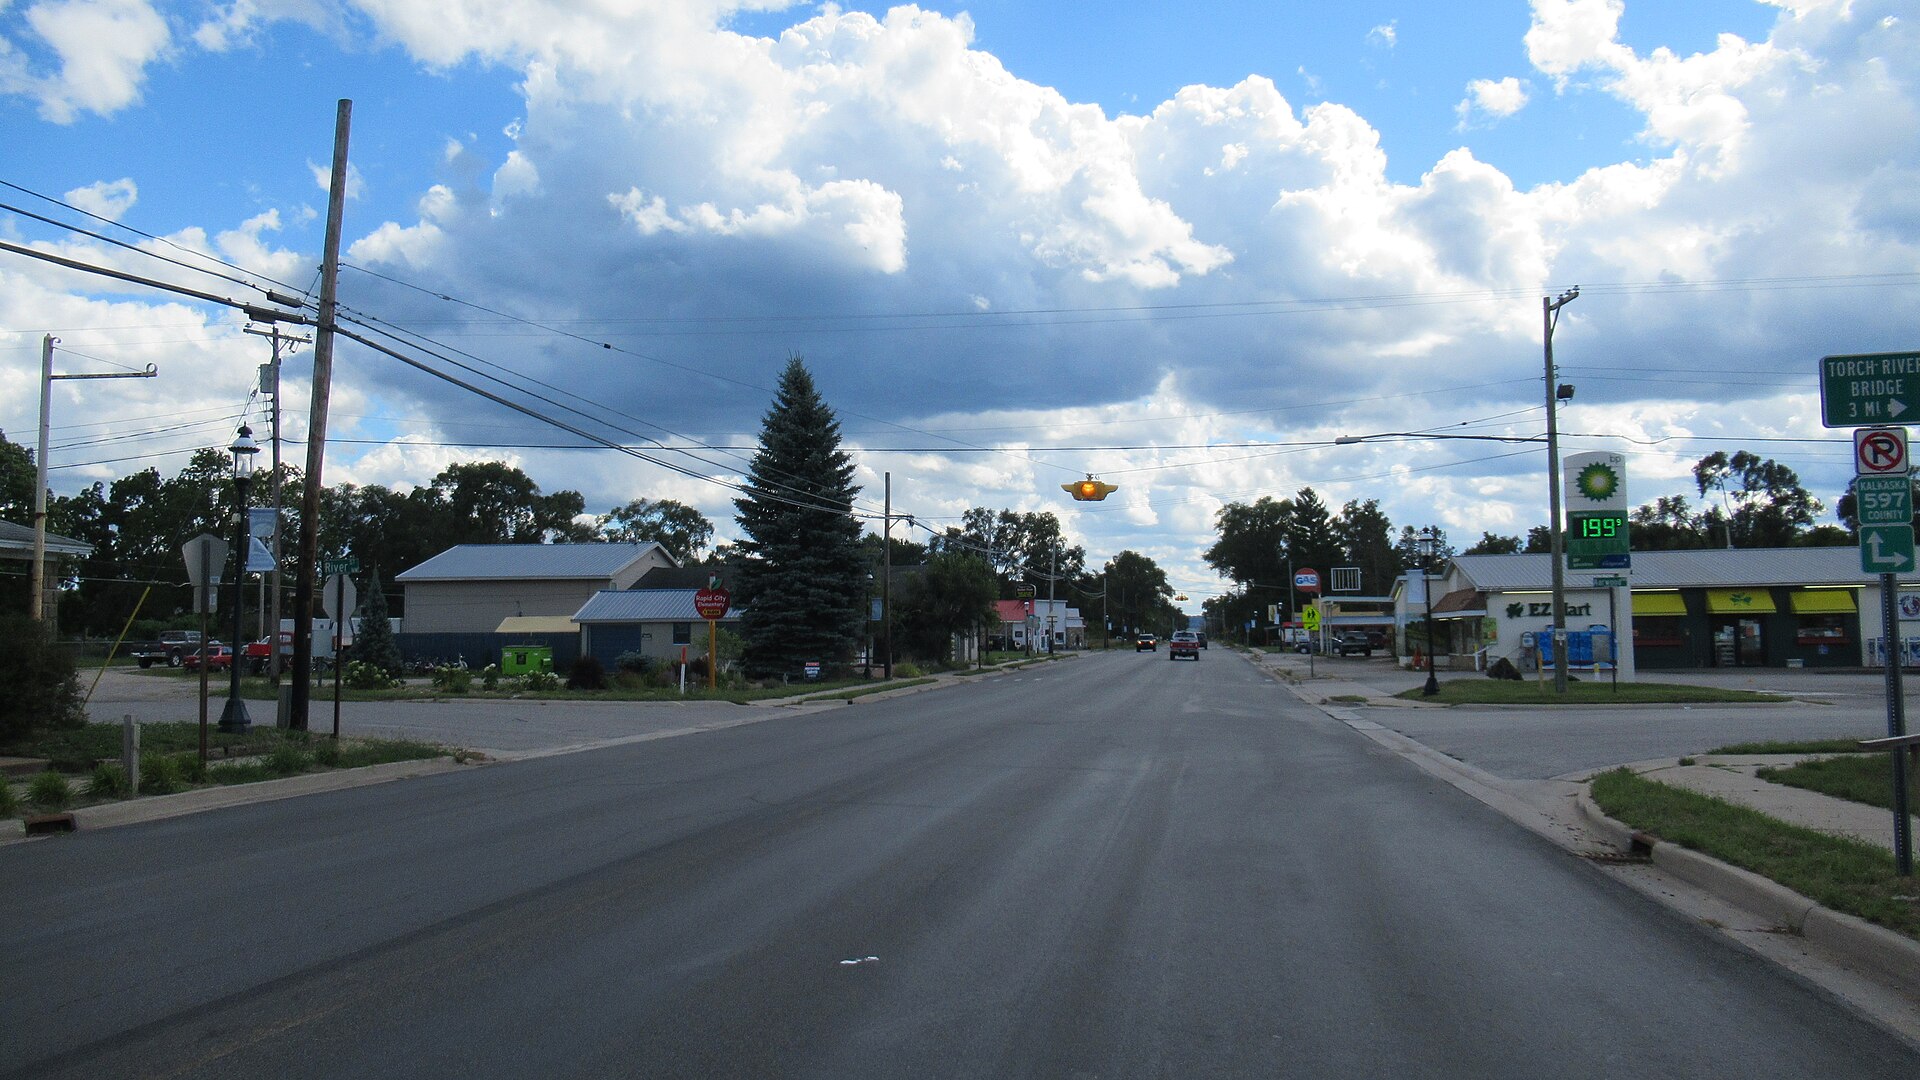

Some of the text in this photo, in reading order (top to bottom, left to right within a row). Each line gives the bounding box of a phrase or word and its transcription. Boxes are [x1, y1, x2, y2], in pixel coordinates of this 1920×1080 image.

[1828, 360, 1874, 377] TORCH
[1851, 379, 1904, 397] BRIDGE
[1849, 402, 1857, 418] 3
[1609, 455, 1622, 465] bp
[1860, 481, 1907, 490] KALKASKA
[1864, 491, 1906, 509] 597
[1867, 509, 1903, 520] COUNTY
[325, 562, 349, 573] River
[1296, 576, 1318, 584] GAS
